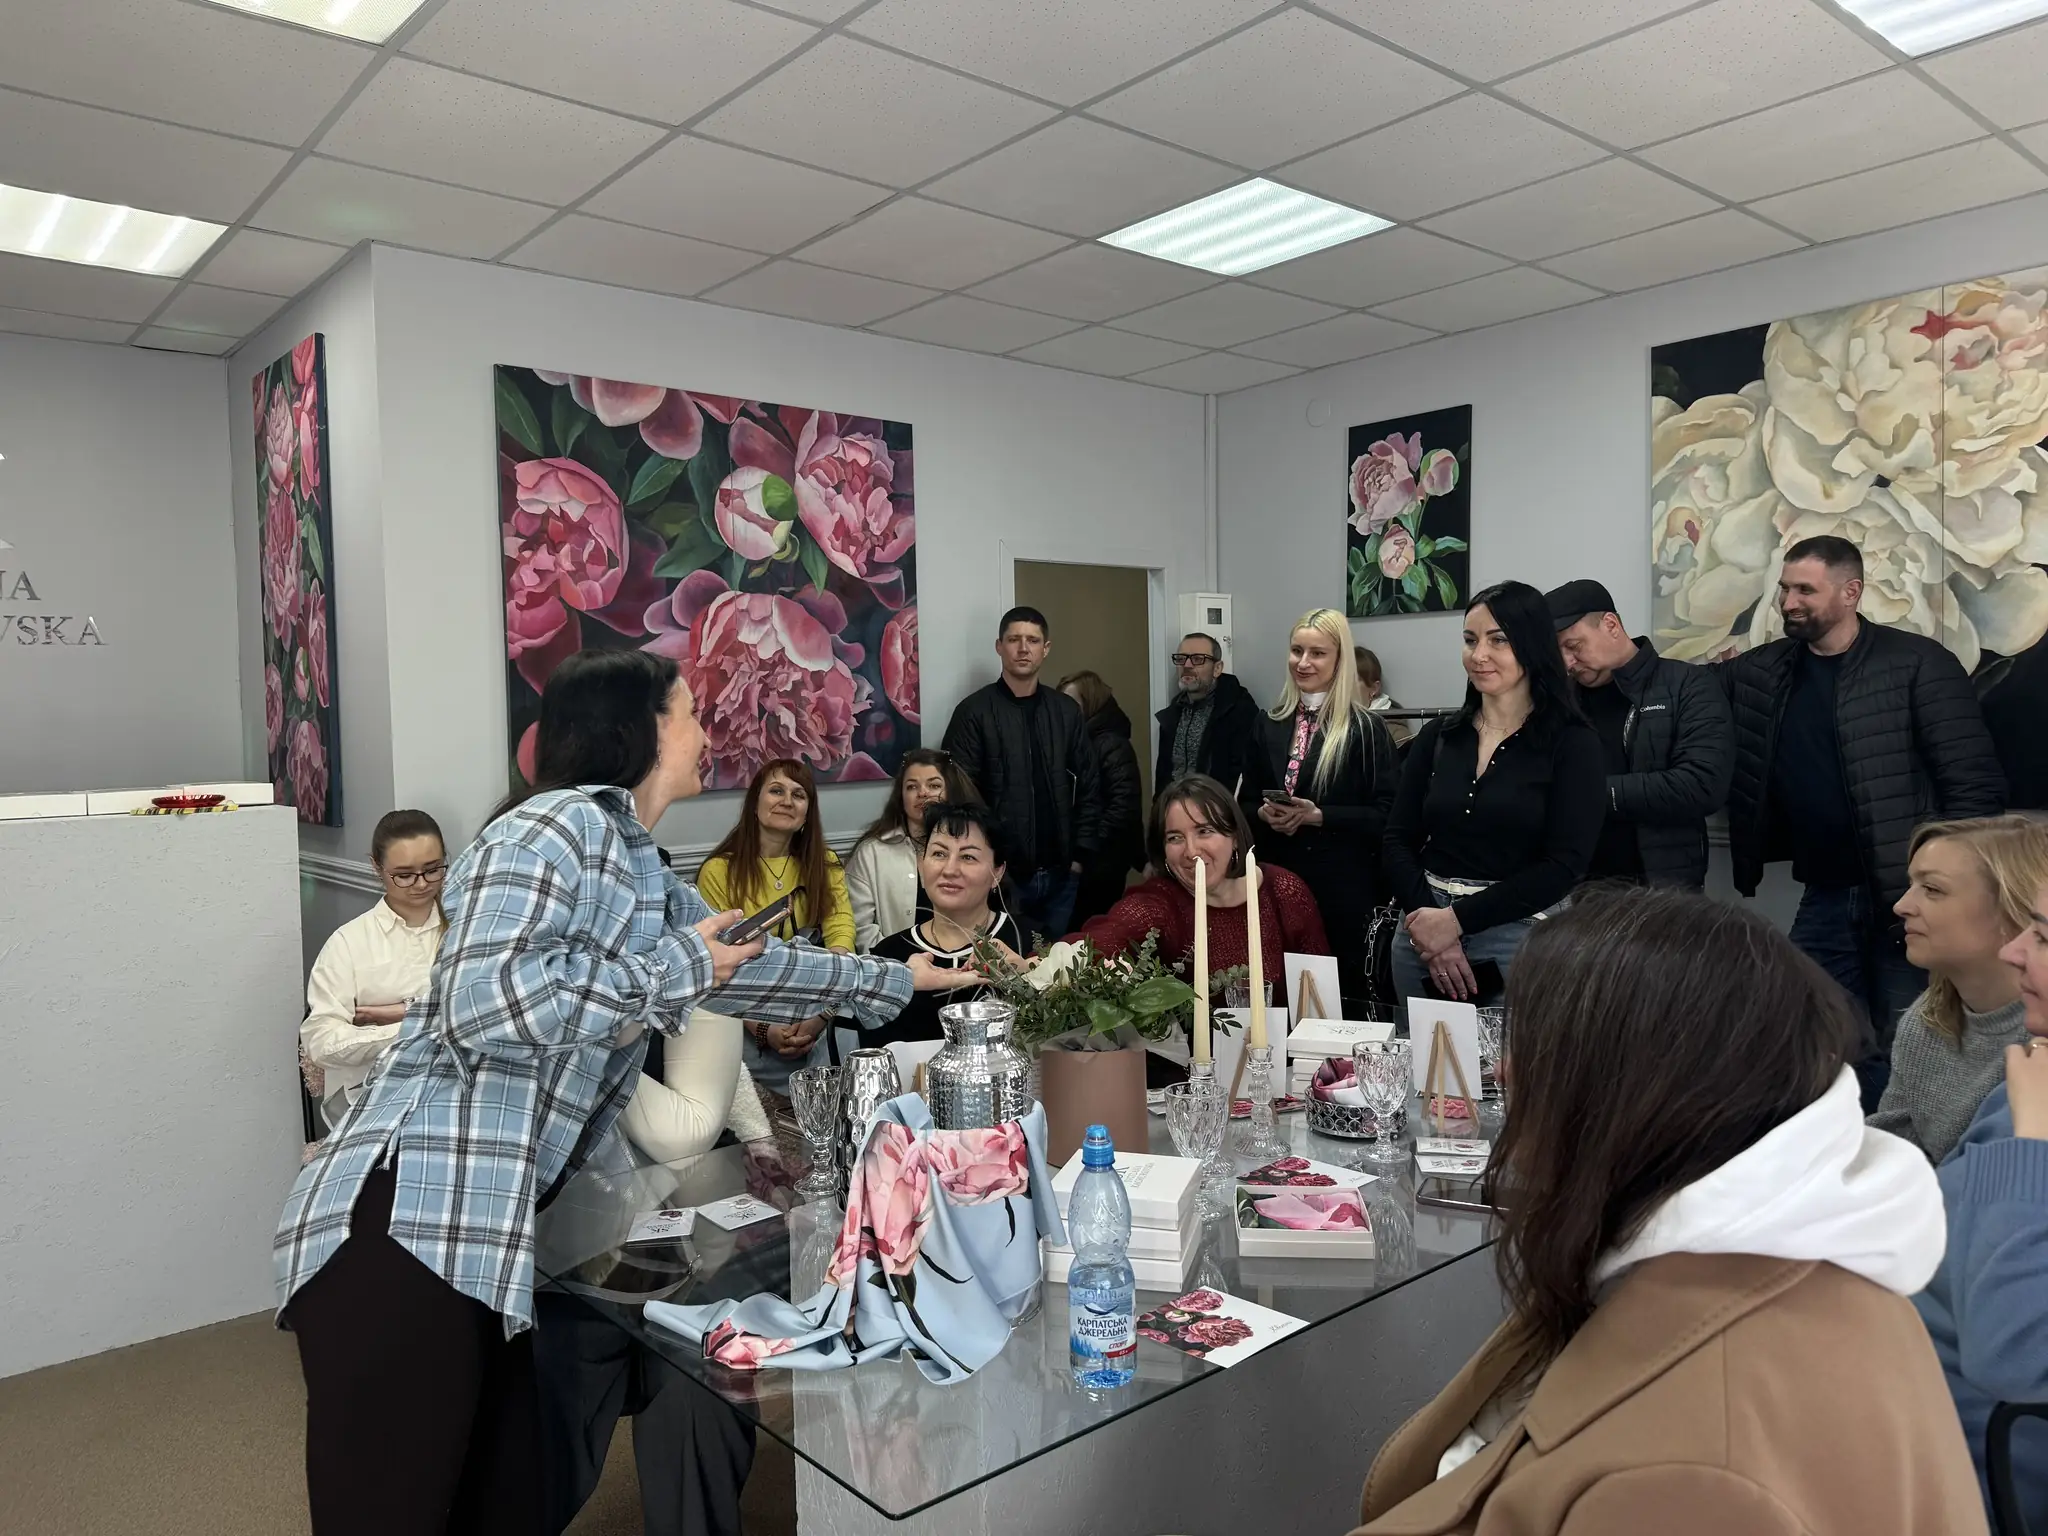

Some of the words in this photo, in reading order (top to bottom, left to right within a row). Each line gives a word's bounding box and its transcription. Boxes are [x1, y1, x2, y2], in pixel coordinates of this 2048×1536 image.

[0, 570, 42, 601] A
[1639, 703, 1666, 713] Columbia
[1077, 1316, 1128, 1329] КАРПАТСЬКА
[1078, 1325, 1128, 1338] ДЖЕРЕЛЬНА
